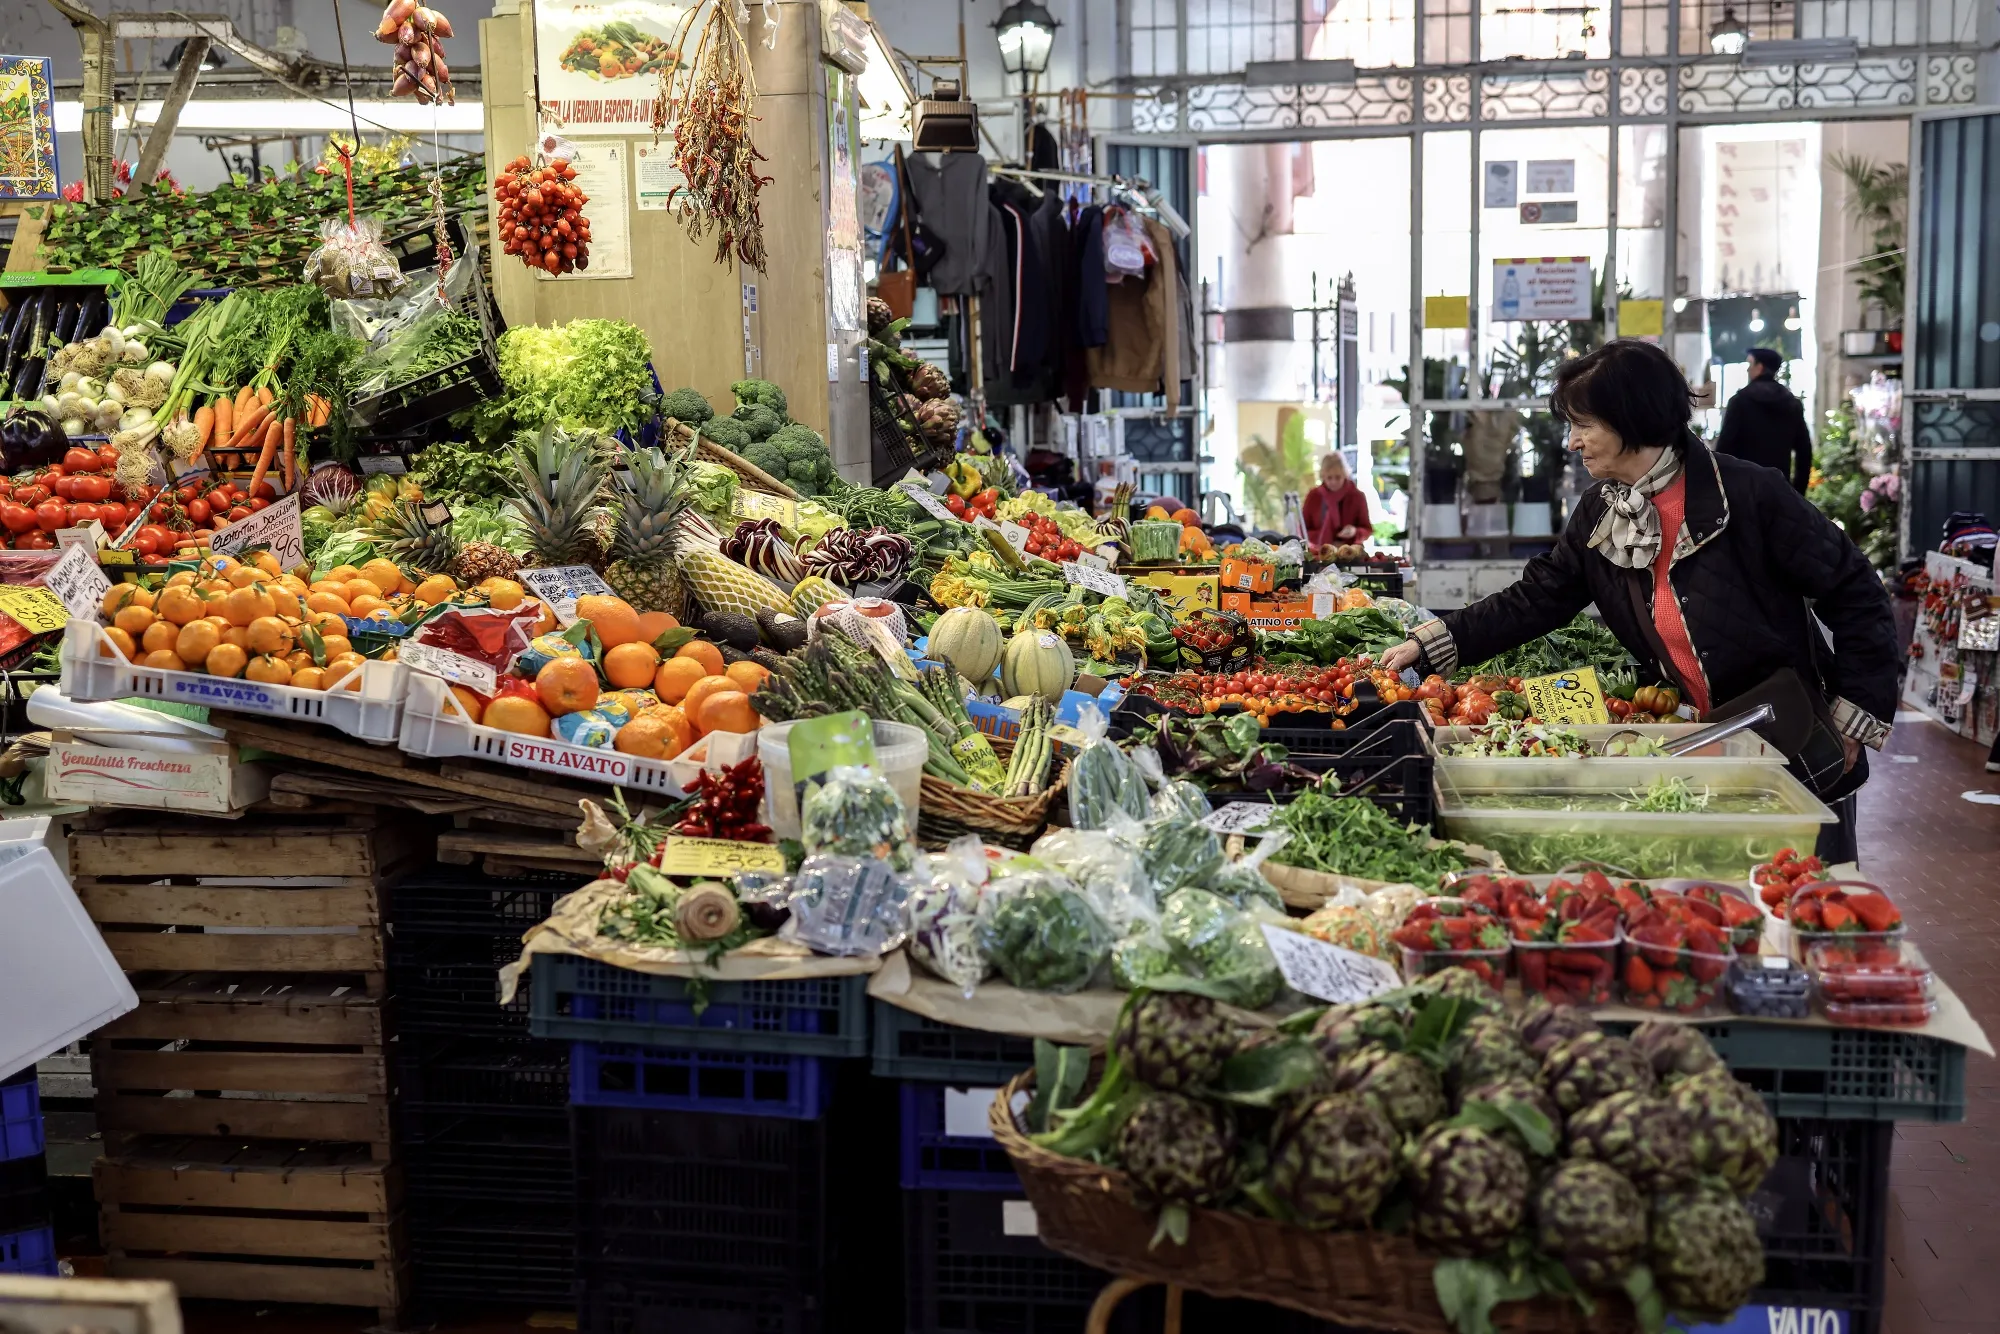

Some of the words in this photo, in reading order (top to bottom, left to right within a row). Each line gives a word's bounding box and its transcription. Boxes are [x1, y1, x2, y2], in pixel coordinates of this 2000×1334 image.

[562, 101, 571, 123] LA
[573, 101, 603, 123] VERDURA
[604, 100, 633, 123] ESPOSTA
[640, 100, 650, 122] UN
[260, 523, 295, 545] PRODOTTO
[176, 681, 269, 703] STRAVATO
[61, 750, 125, 769] Genuinità
[127, 756, 192, 774] Freschezza
[510, 742, 626, 777] STRAVATO
